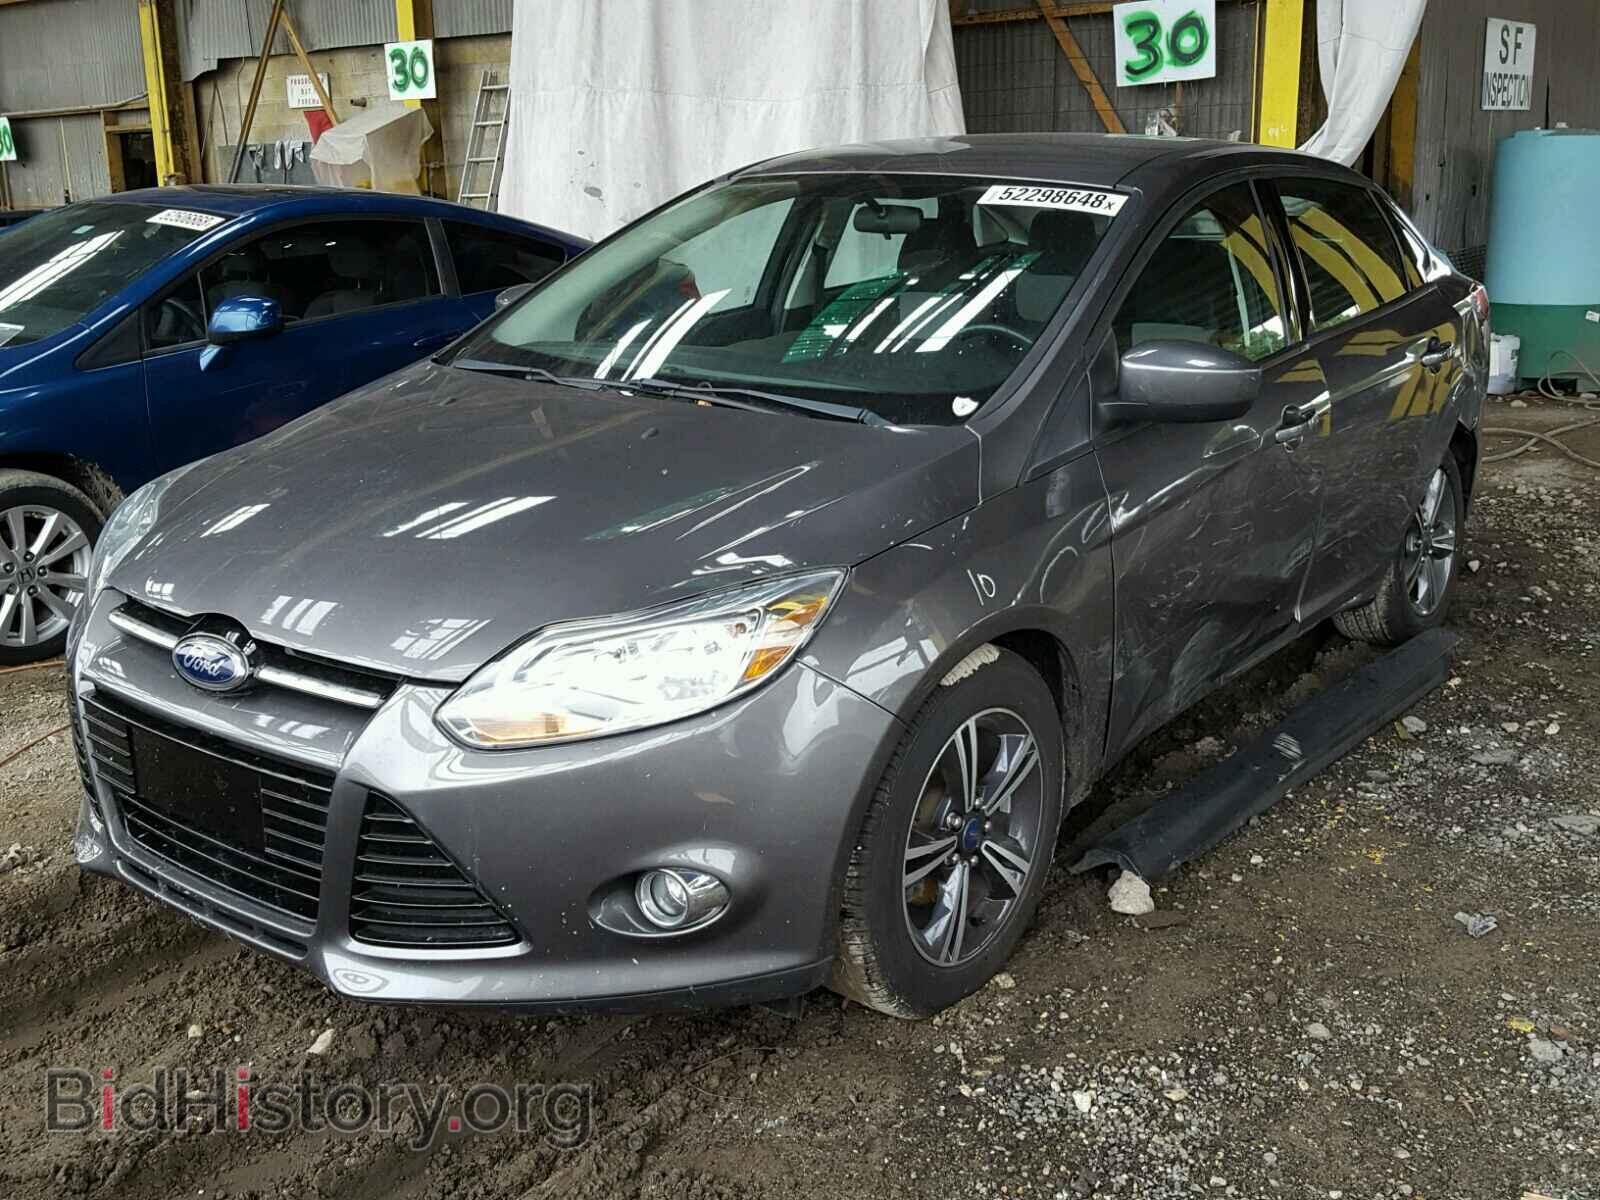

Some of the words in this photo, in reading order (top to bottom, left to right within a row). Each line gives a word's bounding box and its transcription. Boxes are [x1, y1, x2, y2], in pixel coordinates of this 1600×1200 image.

[389, 46, 429, 93] 30
[1124, 10, 1209, 82] 30
[1483, 72, 1531, 107] INSPECTION
